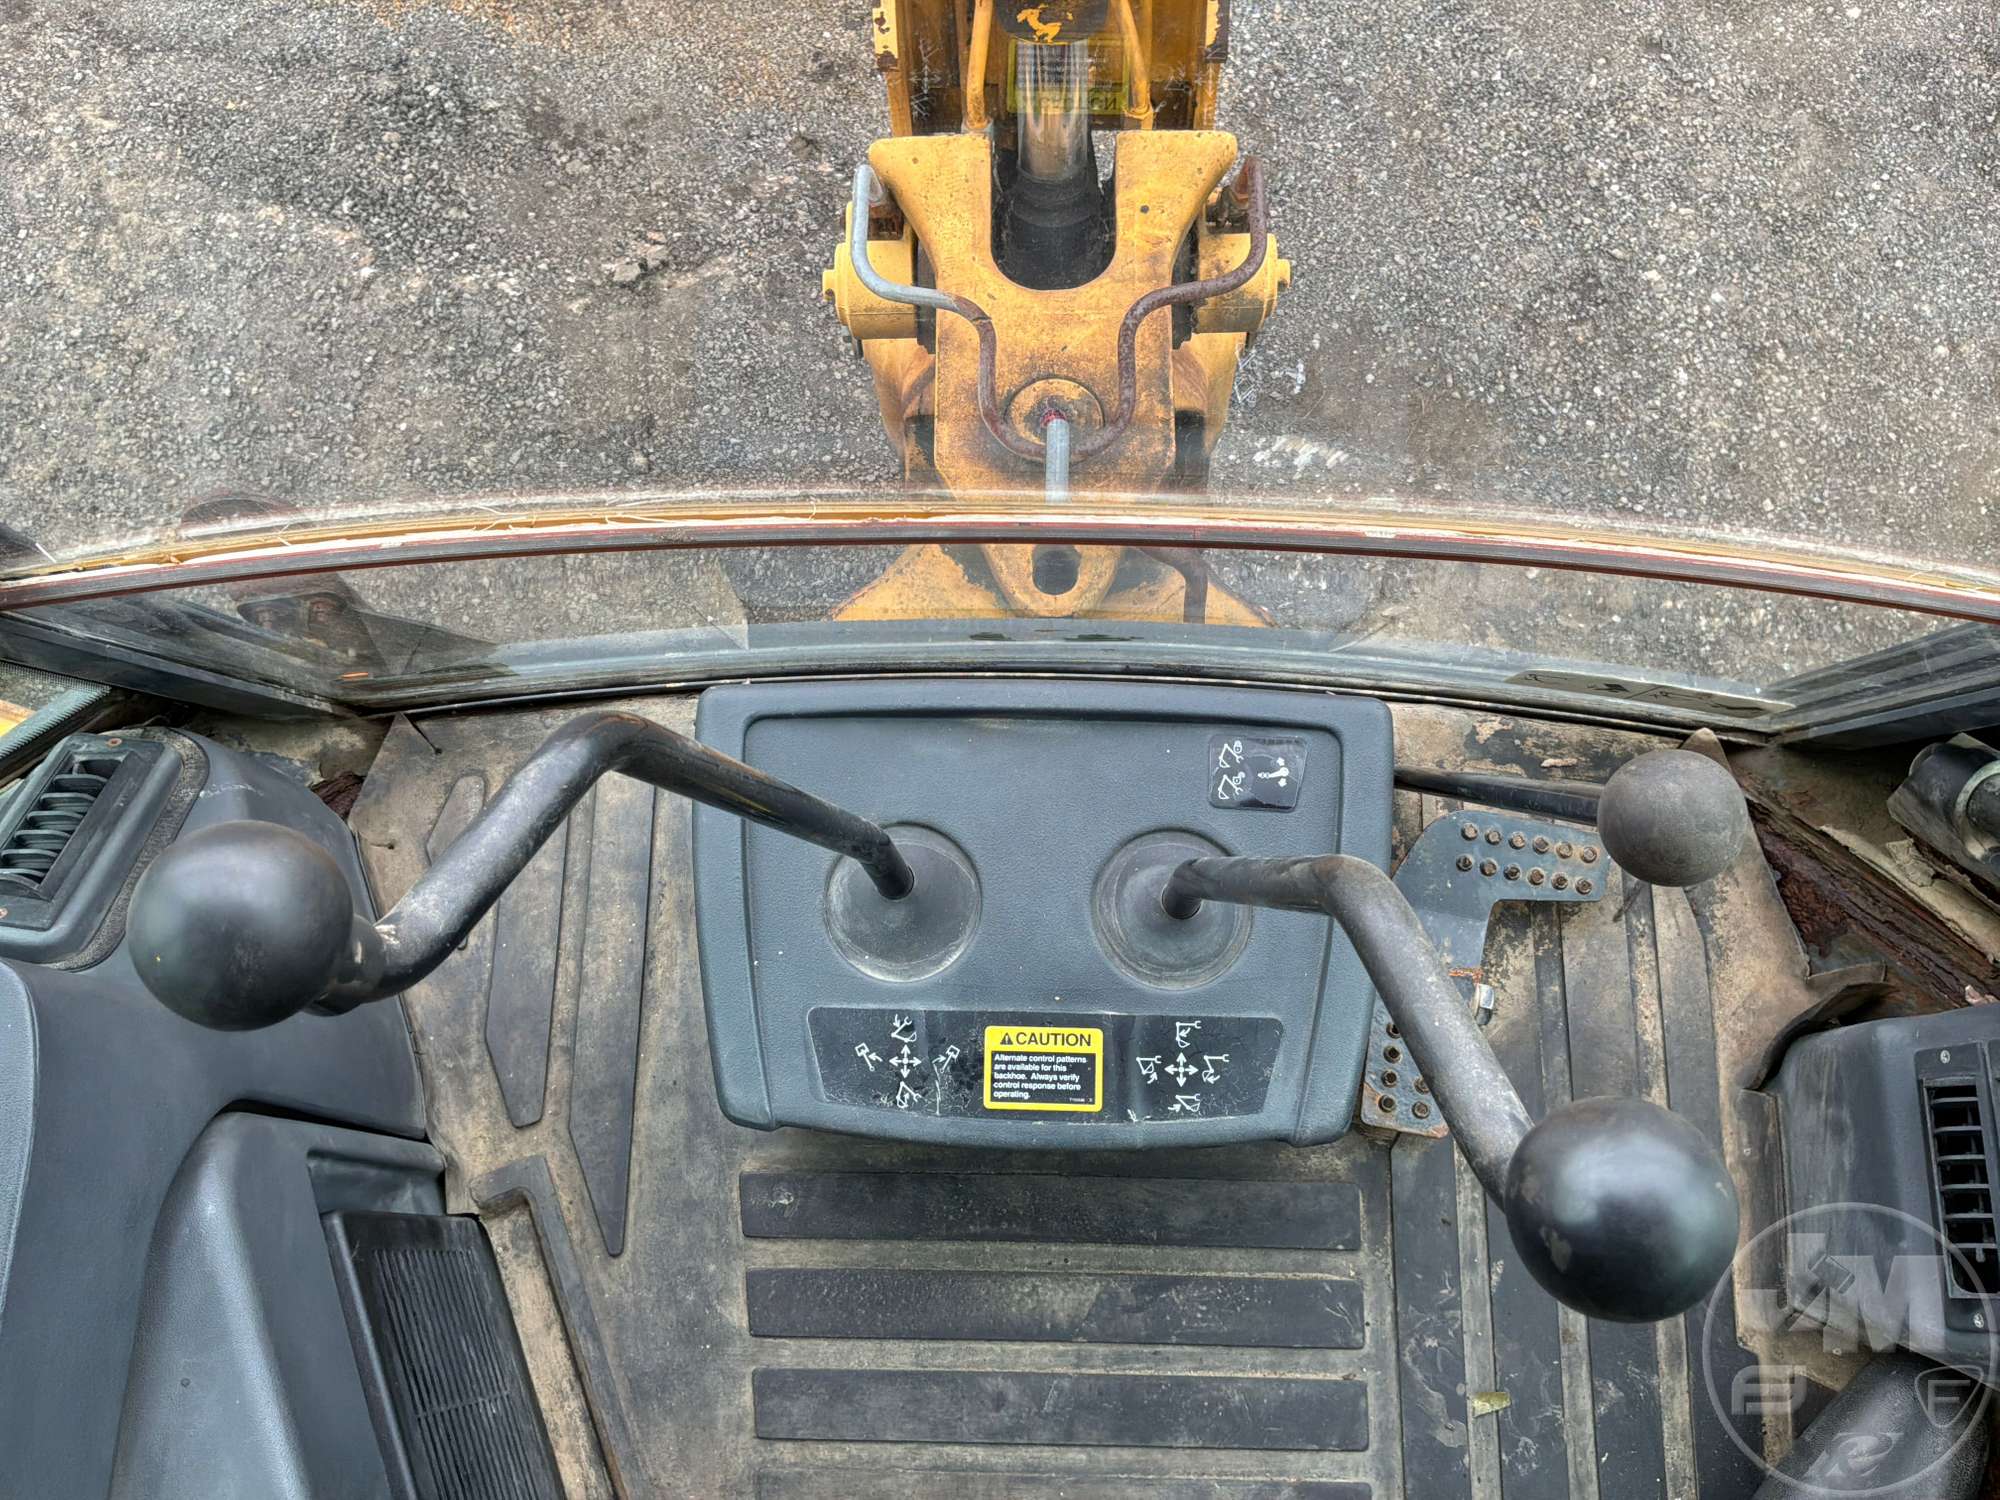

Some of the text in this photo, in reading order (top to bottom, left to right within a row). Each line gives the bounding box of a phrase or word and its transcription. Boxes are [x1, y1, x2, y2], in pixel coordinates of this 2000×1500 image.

[1015, 1031, 1092, 1047] CAUTION
[994, 1053, 1087, 1065] Alternate control patterns
[1007, 1063, 1040, 1072] available
[1041, 1063, 1052, 1072] for
[1052, 1064, 1067, 1073] this
[994, 1072, 1081, 1083] backhoe. Always verify
[993, 1081, 1082, 1091] control response before
[993, 1090, 1031, 1100] operating.
